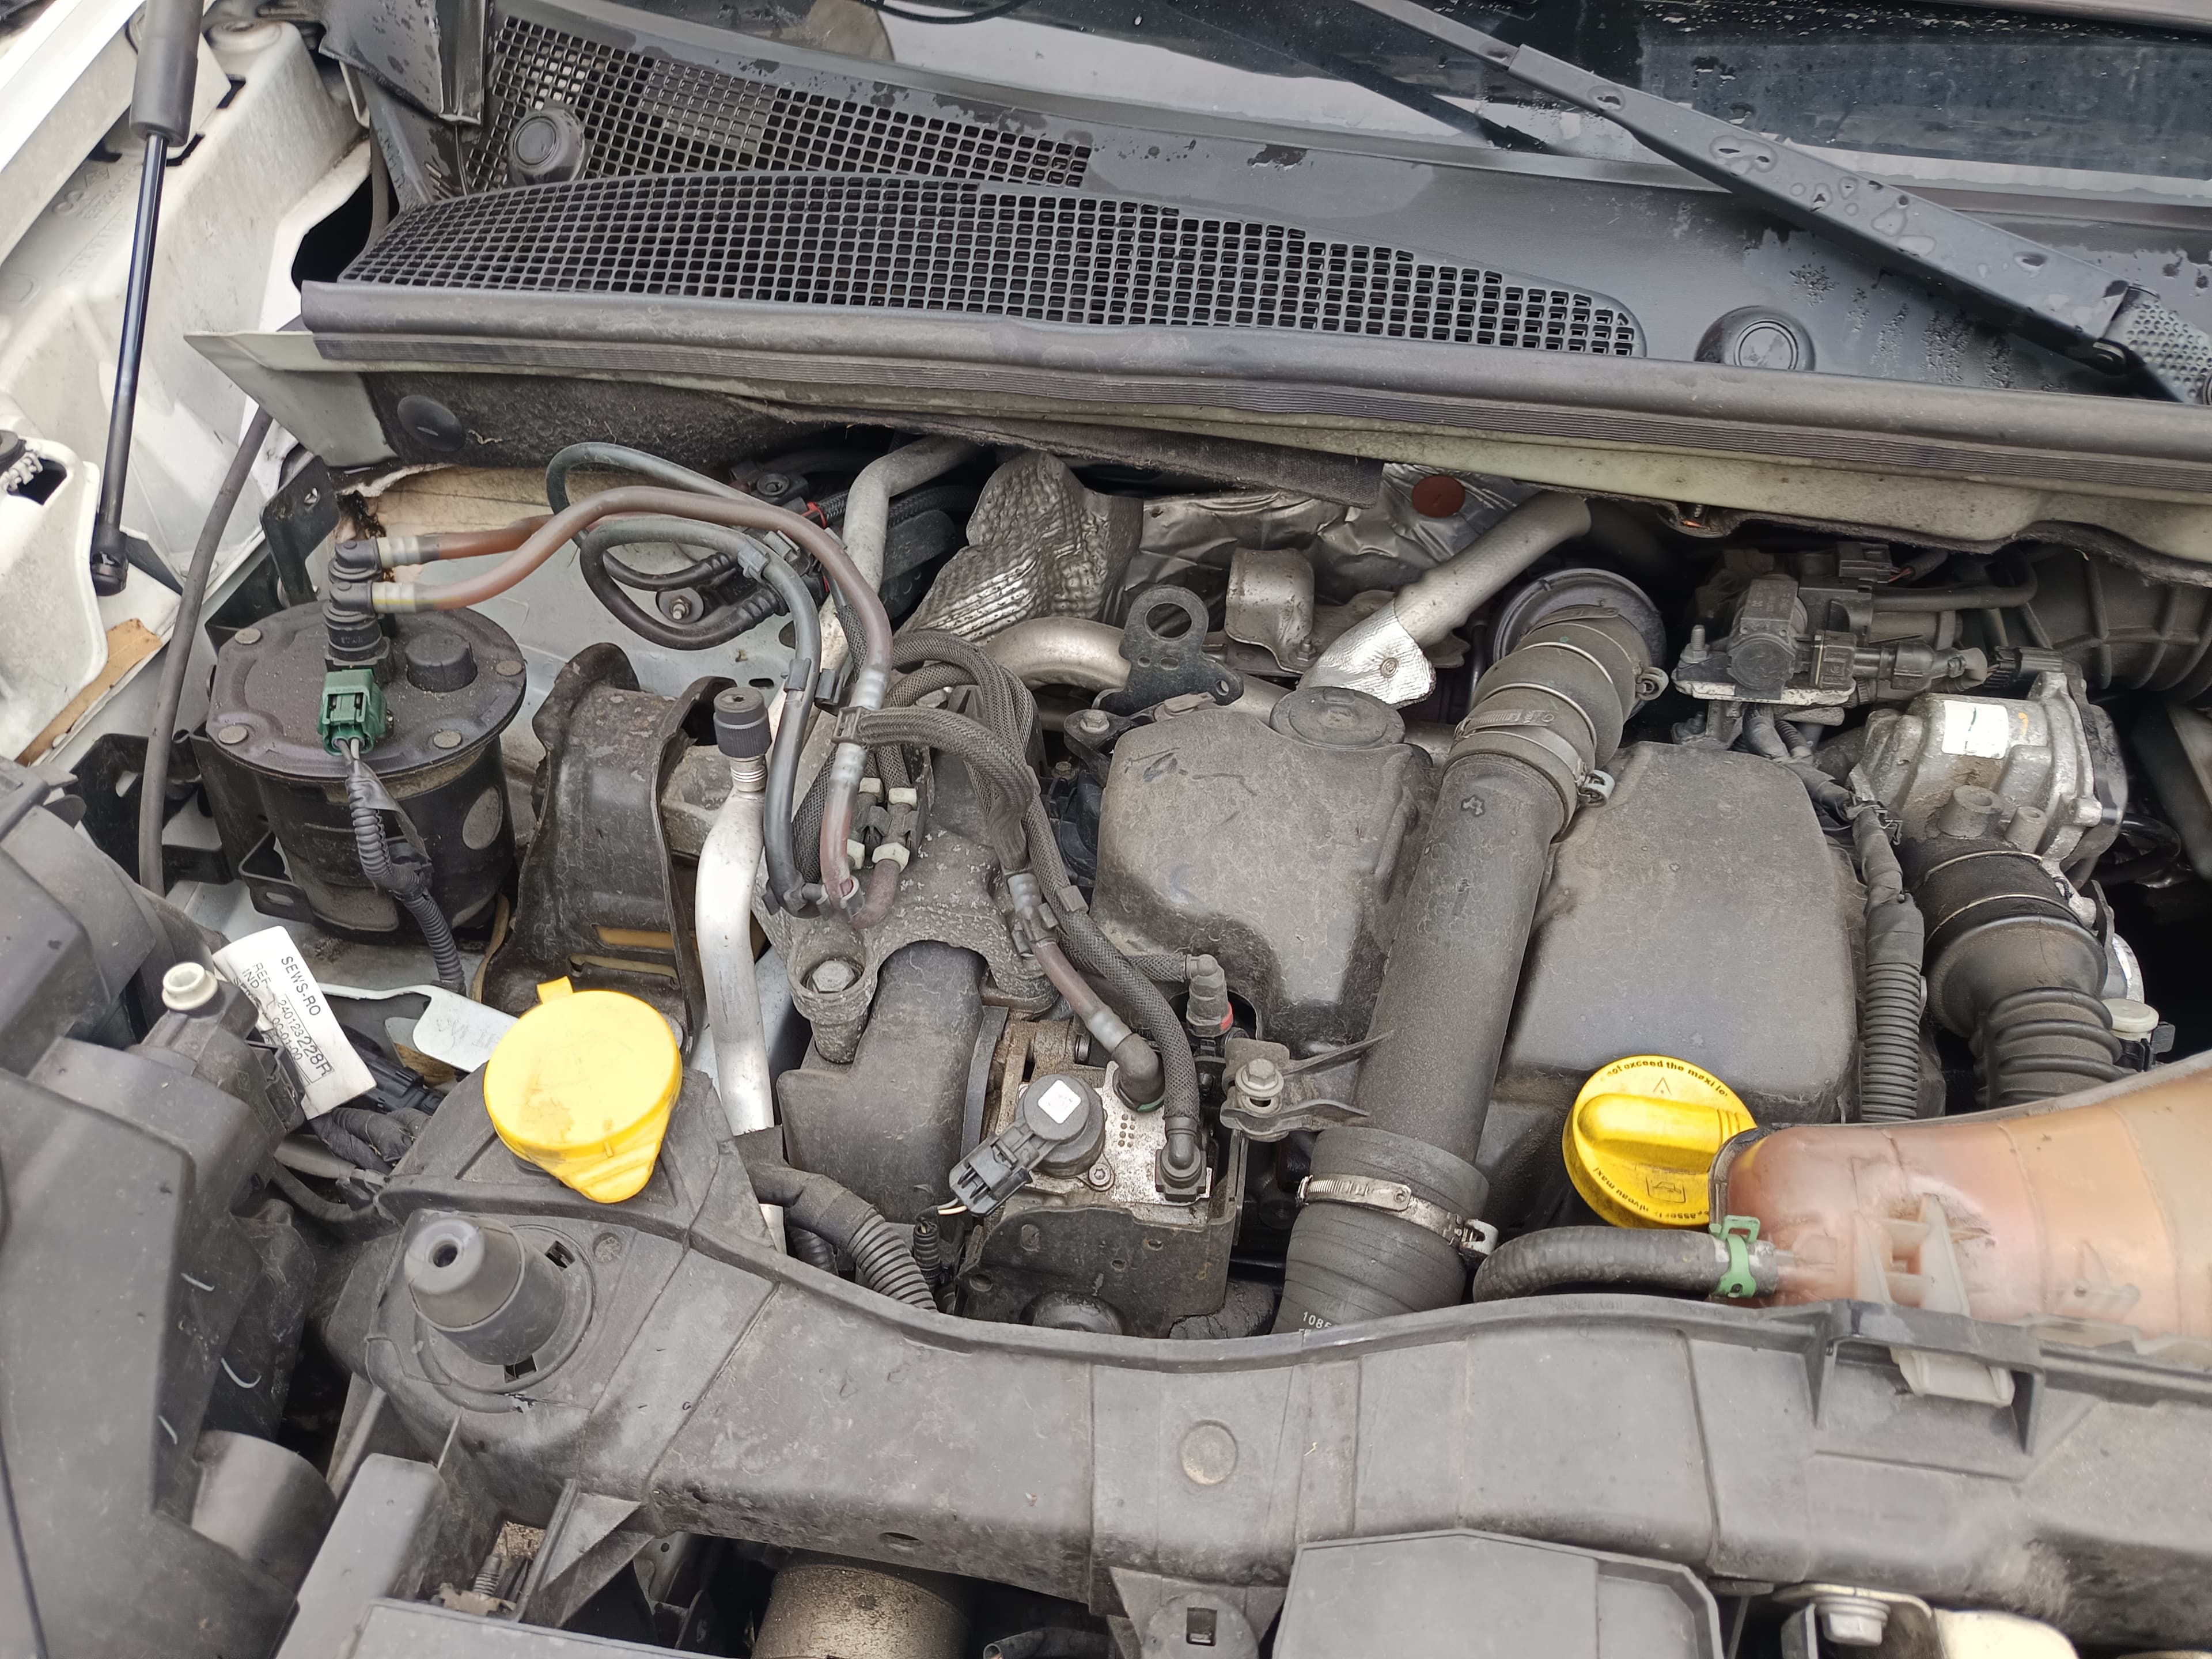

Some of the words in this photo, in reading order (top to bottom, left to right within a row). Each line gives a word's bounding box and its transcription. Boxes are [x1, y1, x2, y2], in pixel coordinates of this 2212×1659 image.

[242, 969, 260, 988] IND
[252, 963, 272, 987] REF
[282, 956, 321, 1016] SEWS-RO
[1624, 1060, 1664, 1071] exceed
[1666, 1061, 1684, 1072] the
[1688, 1069, 1715, 1088] maxi
[1593, 1167, 1615, 1190] maxi
